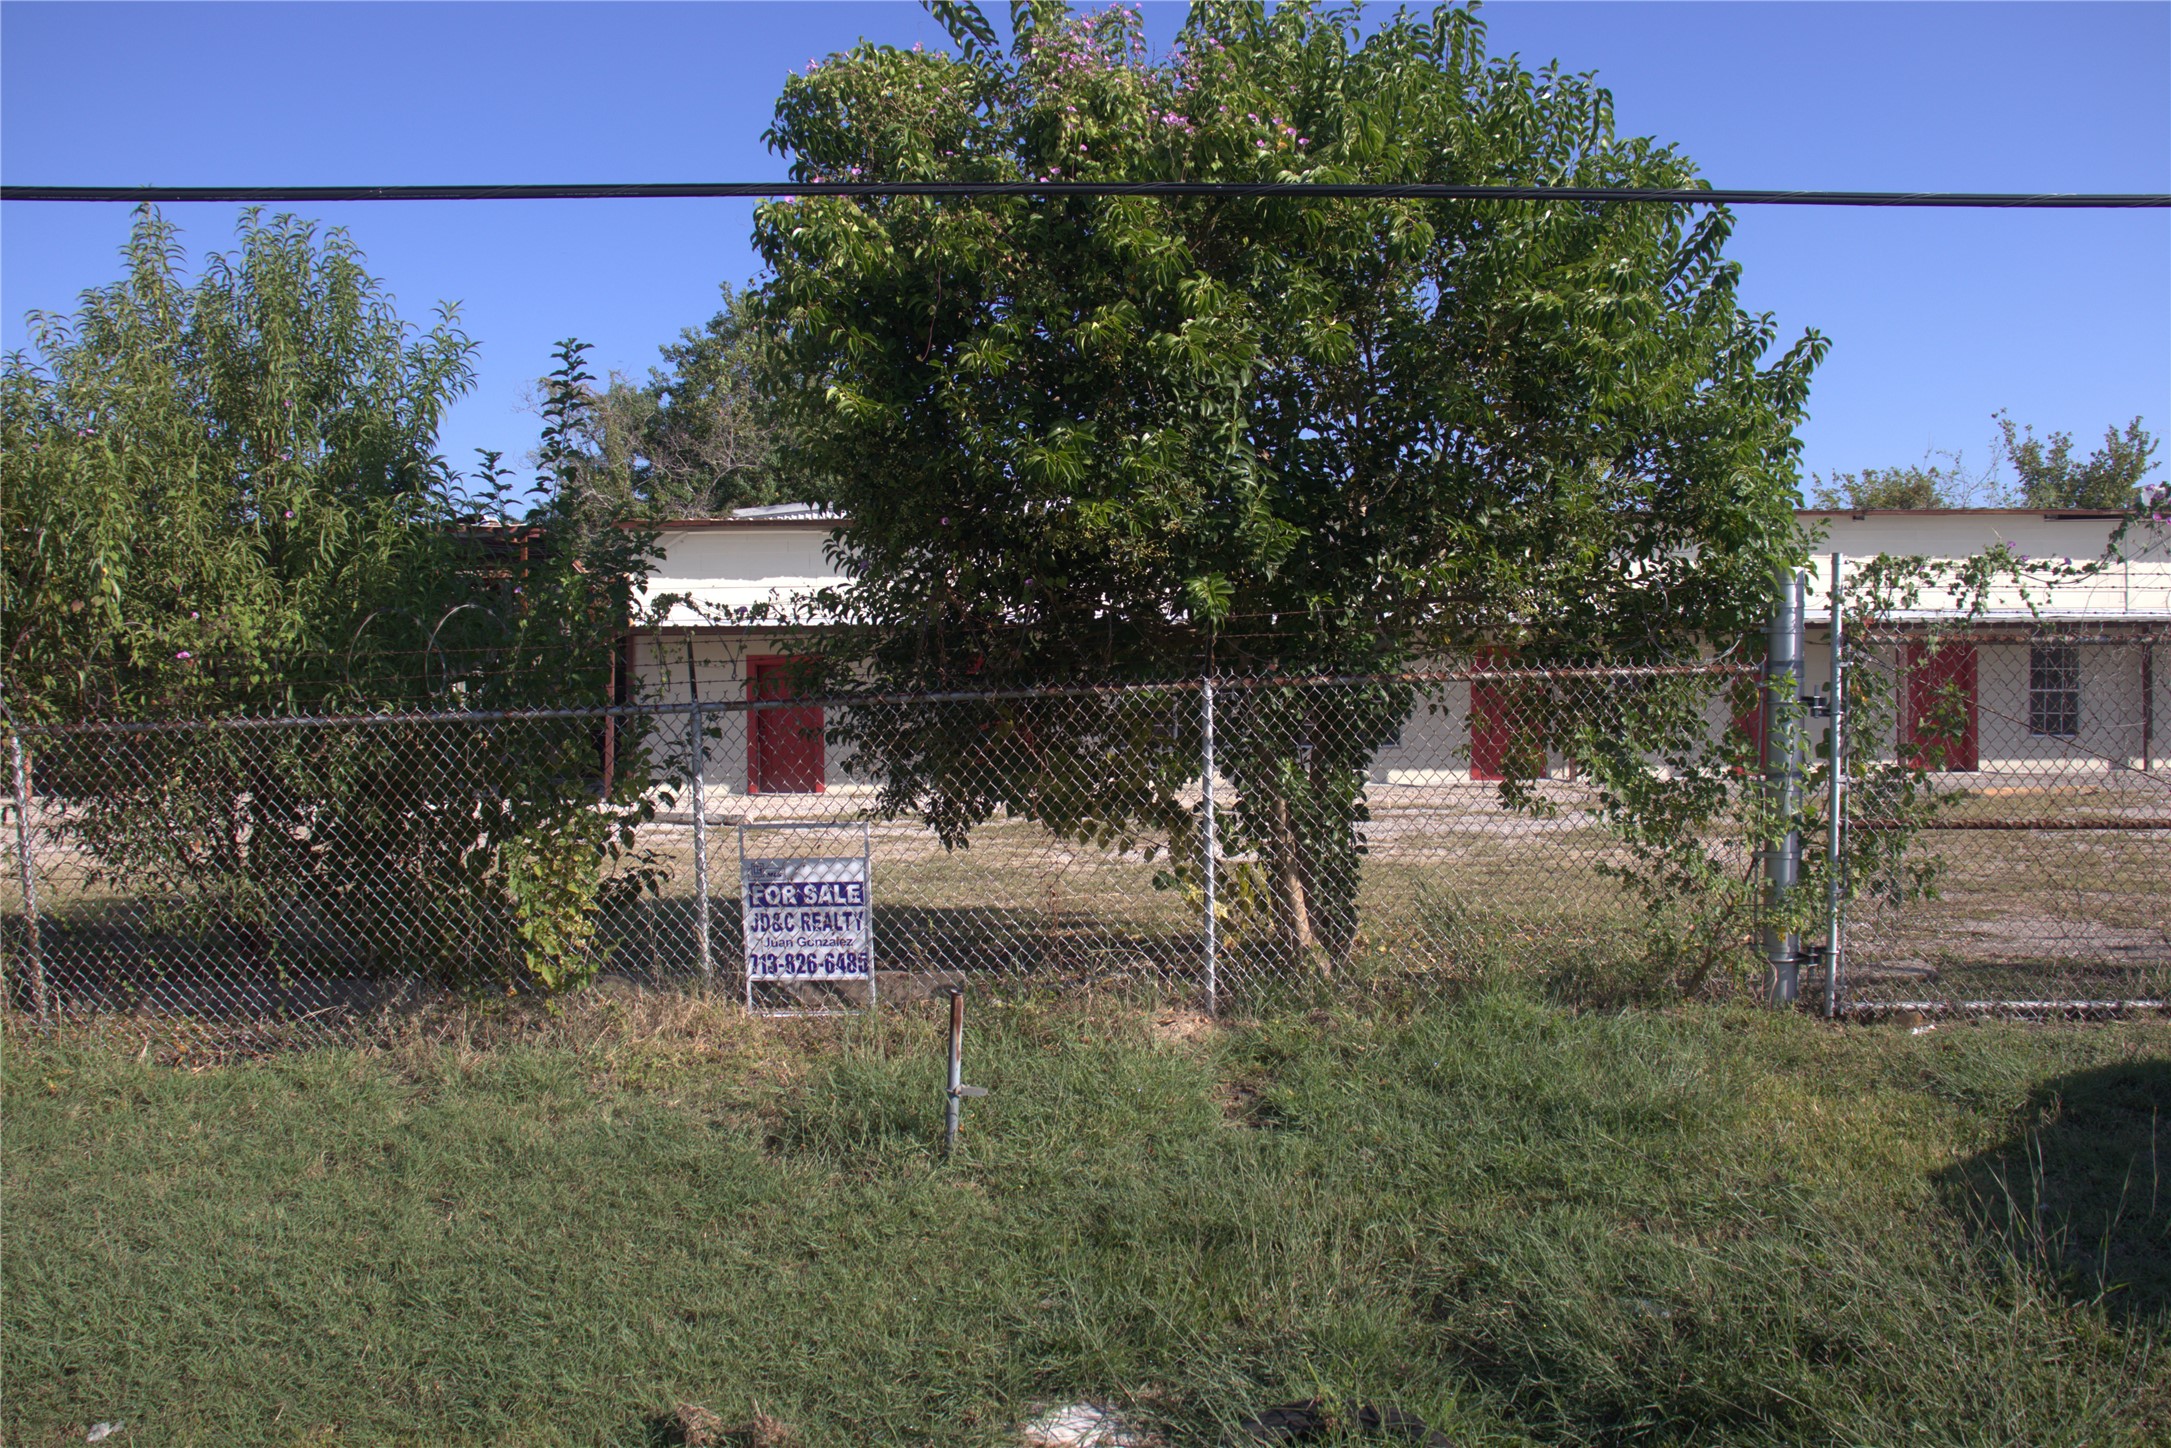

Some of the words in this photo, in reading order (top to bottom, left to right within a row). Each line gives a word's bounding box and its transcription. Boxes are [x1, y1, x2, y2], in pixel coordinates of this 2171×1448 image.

[752, 884, 798, 905] FOR
[803, 883, 861, 905] SALE
[750, 912, 795, 933] JD&C
[801, 911, 864, 932] REALTY
[764, 937, 793, 948] Juan
[796, 936, 853, 948] Gonzalez
[750, 952, 869, 975] 713-826-6485
